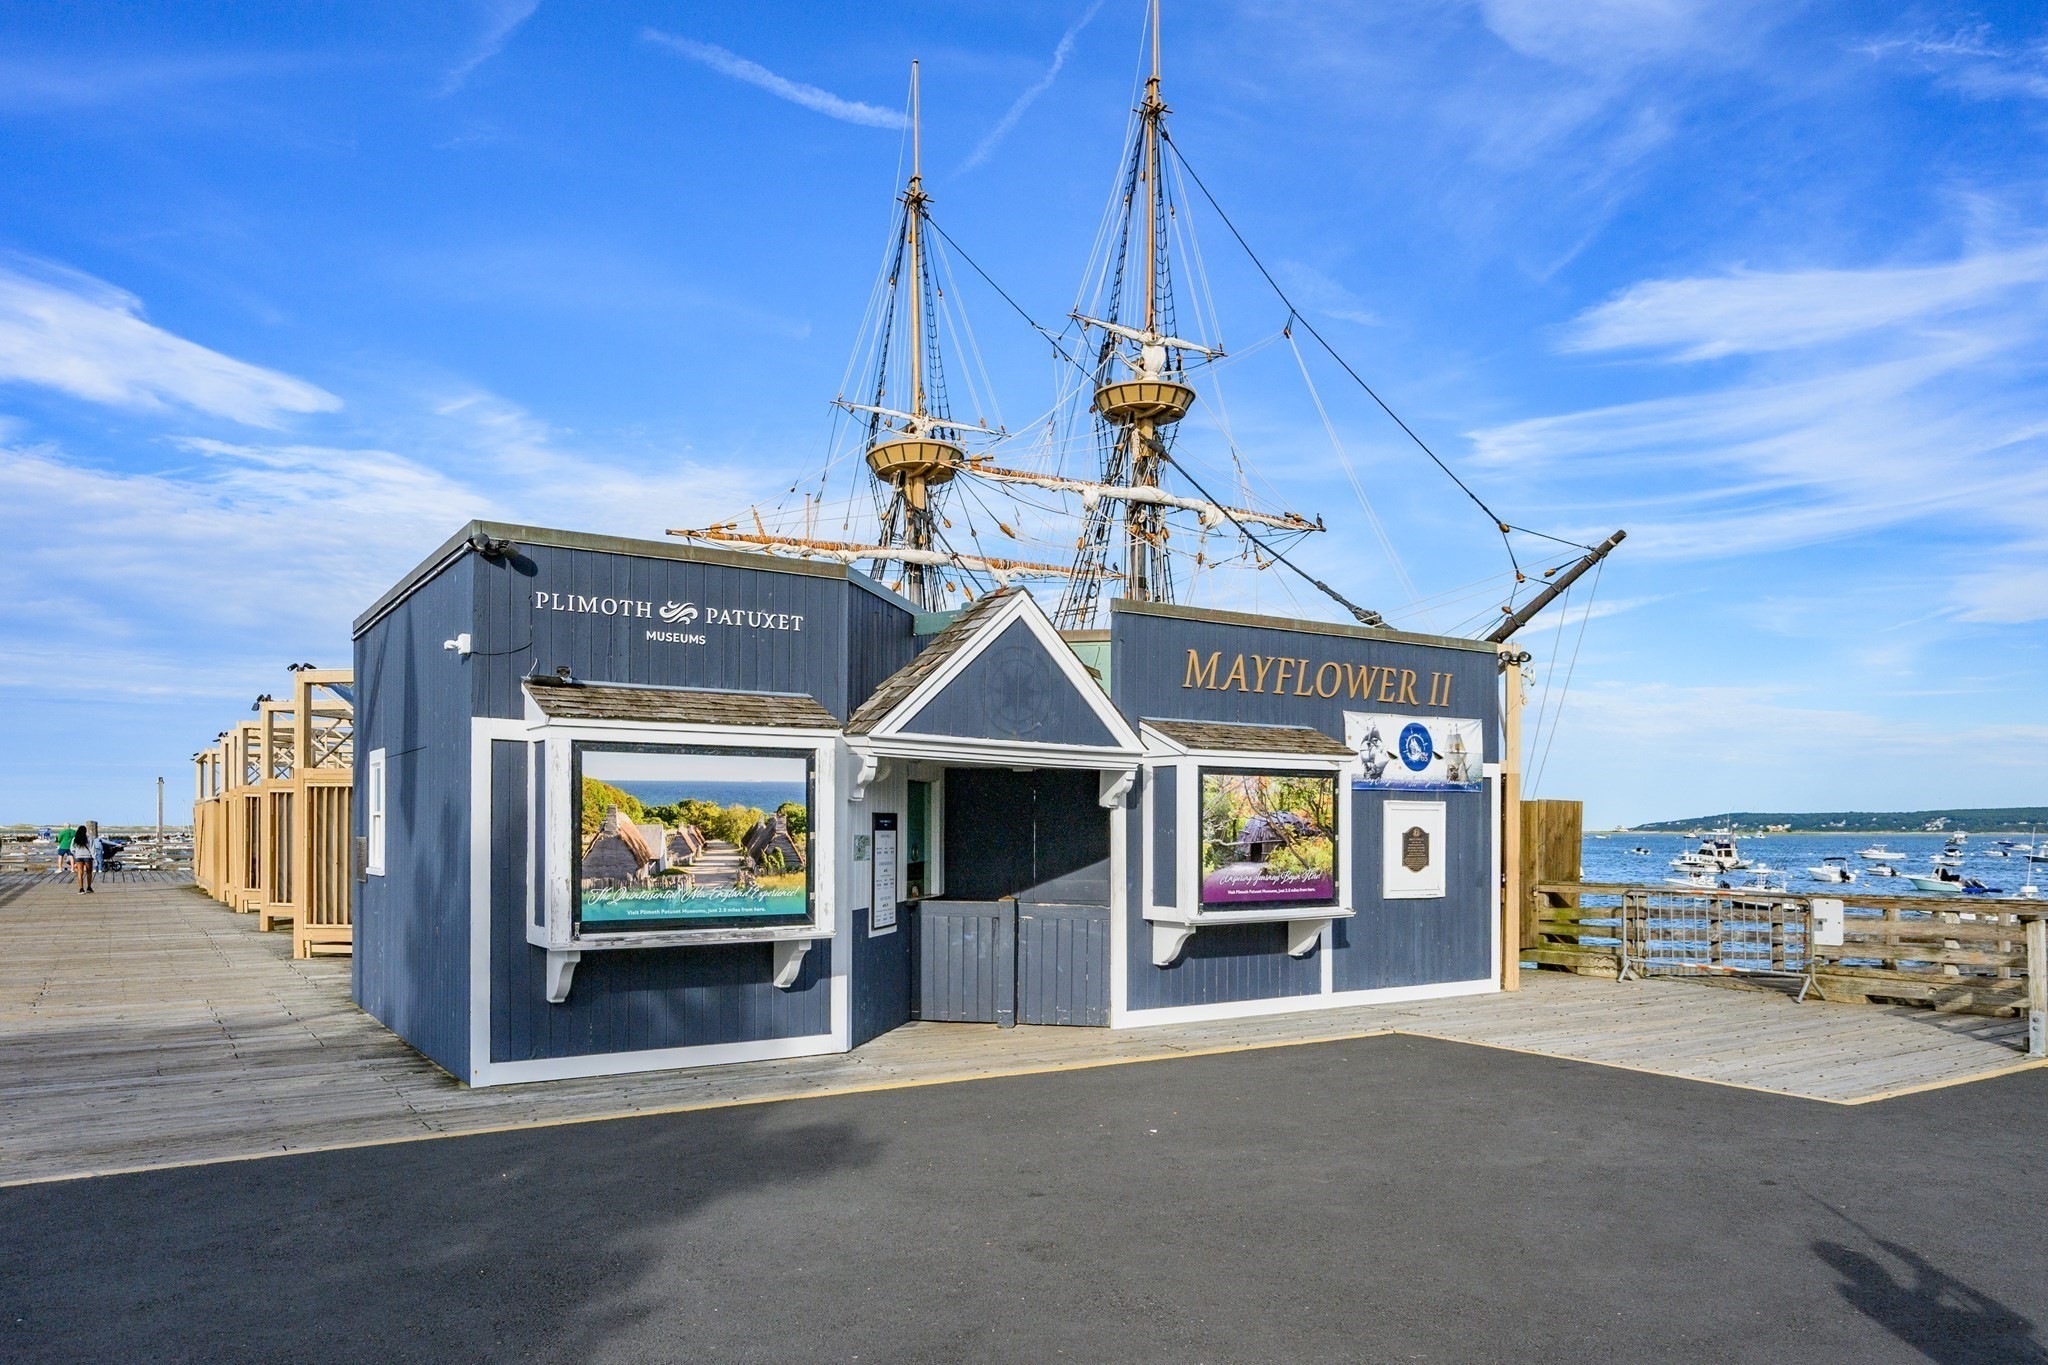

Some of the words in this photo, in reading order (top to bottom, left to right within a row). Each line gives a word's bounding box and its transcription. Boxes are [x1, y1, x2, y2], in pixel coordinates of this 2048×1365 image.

[535, 591, 653, 619] PLIMOTH
[705, 607, 804, 632] PATUXET
[646, 630, 706, 646] MUSEUMS
[1182, 649, 1420, 706] MAYFLOWER
[1428, 671, 1453, 707] II
[587, 887, 612, 905] The
[606, 886, 683, 905] Quintessential
[681, 886, 708, 903] New
[709, 885, 754, 903] England
[750, 886, 800, 902] Experience!
